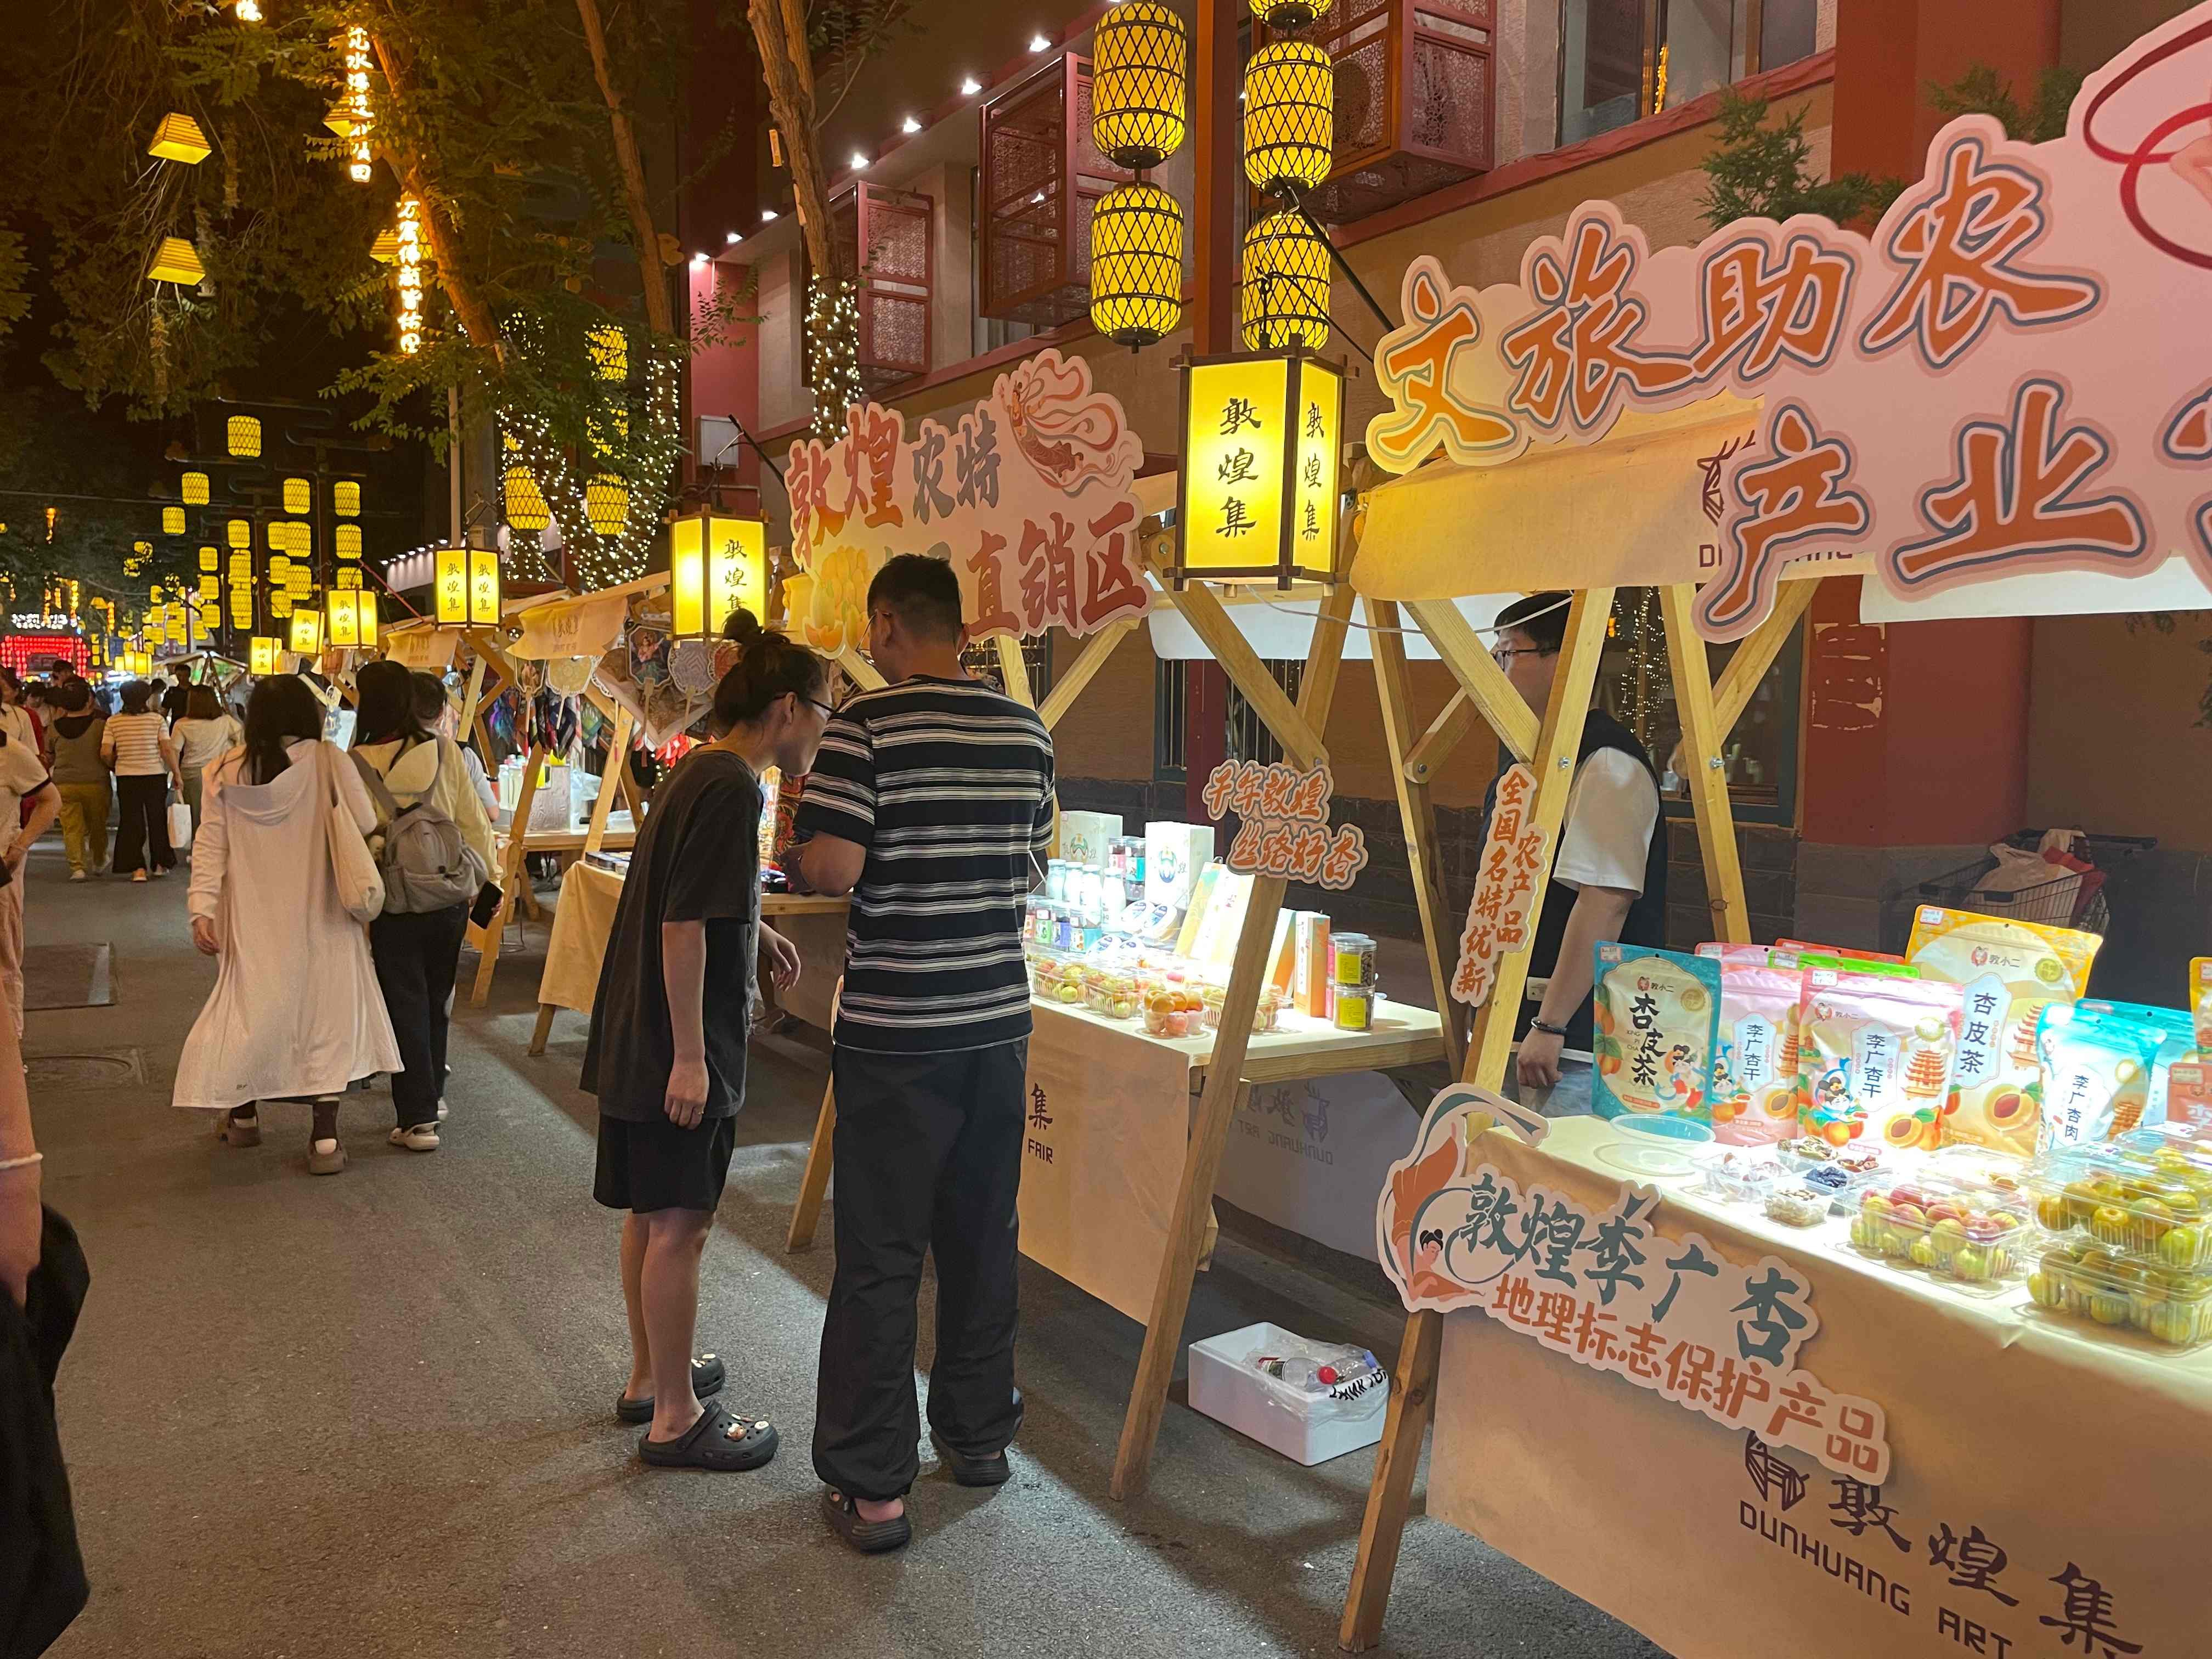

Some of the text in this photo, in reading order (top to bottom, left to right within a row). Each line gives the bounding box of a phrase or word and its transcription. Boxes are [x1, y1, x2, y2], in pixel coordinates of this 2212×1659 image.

[1376, 138, 2099, 458] 文旅助农
[788, 409, 1001, 568] 敦煌农特
[1216, 398, 1261, 538] 敦煌集
[1302, 402, 1324, 541] 敦煌集
[1705, 379, 2212, 625] 产业
[447, 563, 460, 612] 敦煌集
[478, 563, 490, 612] 敦煌集
[884, 502, 1147, 633] 直销区
[1207, 768, 1323, 818] 千年敦煌
[1232, 823, 1357, 879] 丝路好杏
[1457, 771, 1530, 997] 全国名特优新
[1496, 831, 1542, 944] 农产品
[1629, 992, 1667, 1087] 杏皮茶
[1743, 1024, 1764, 1081] 李广杏干
[1862, 1034, 1886, 1098] 李广杏干
[1960, 992, 1998, 1074] 杏皮茶
[1027, 1138, 1053, 1165] FAIR
[1028, 1083, 1053, 1130] 集
[2064, 1074, 2090, 1141] 李广杏肉
[1492, 1273, 1879, 1475] 地理标志保护产品
[1740, 1500, 2013, 1659] DUNHUANG ART
[1829, 1476, 2143, 1659] 敦煌集
